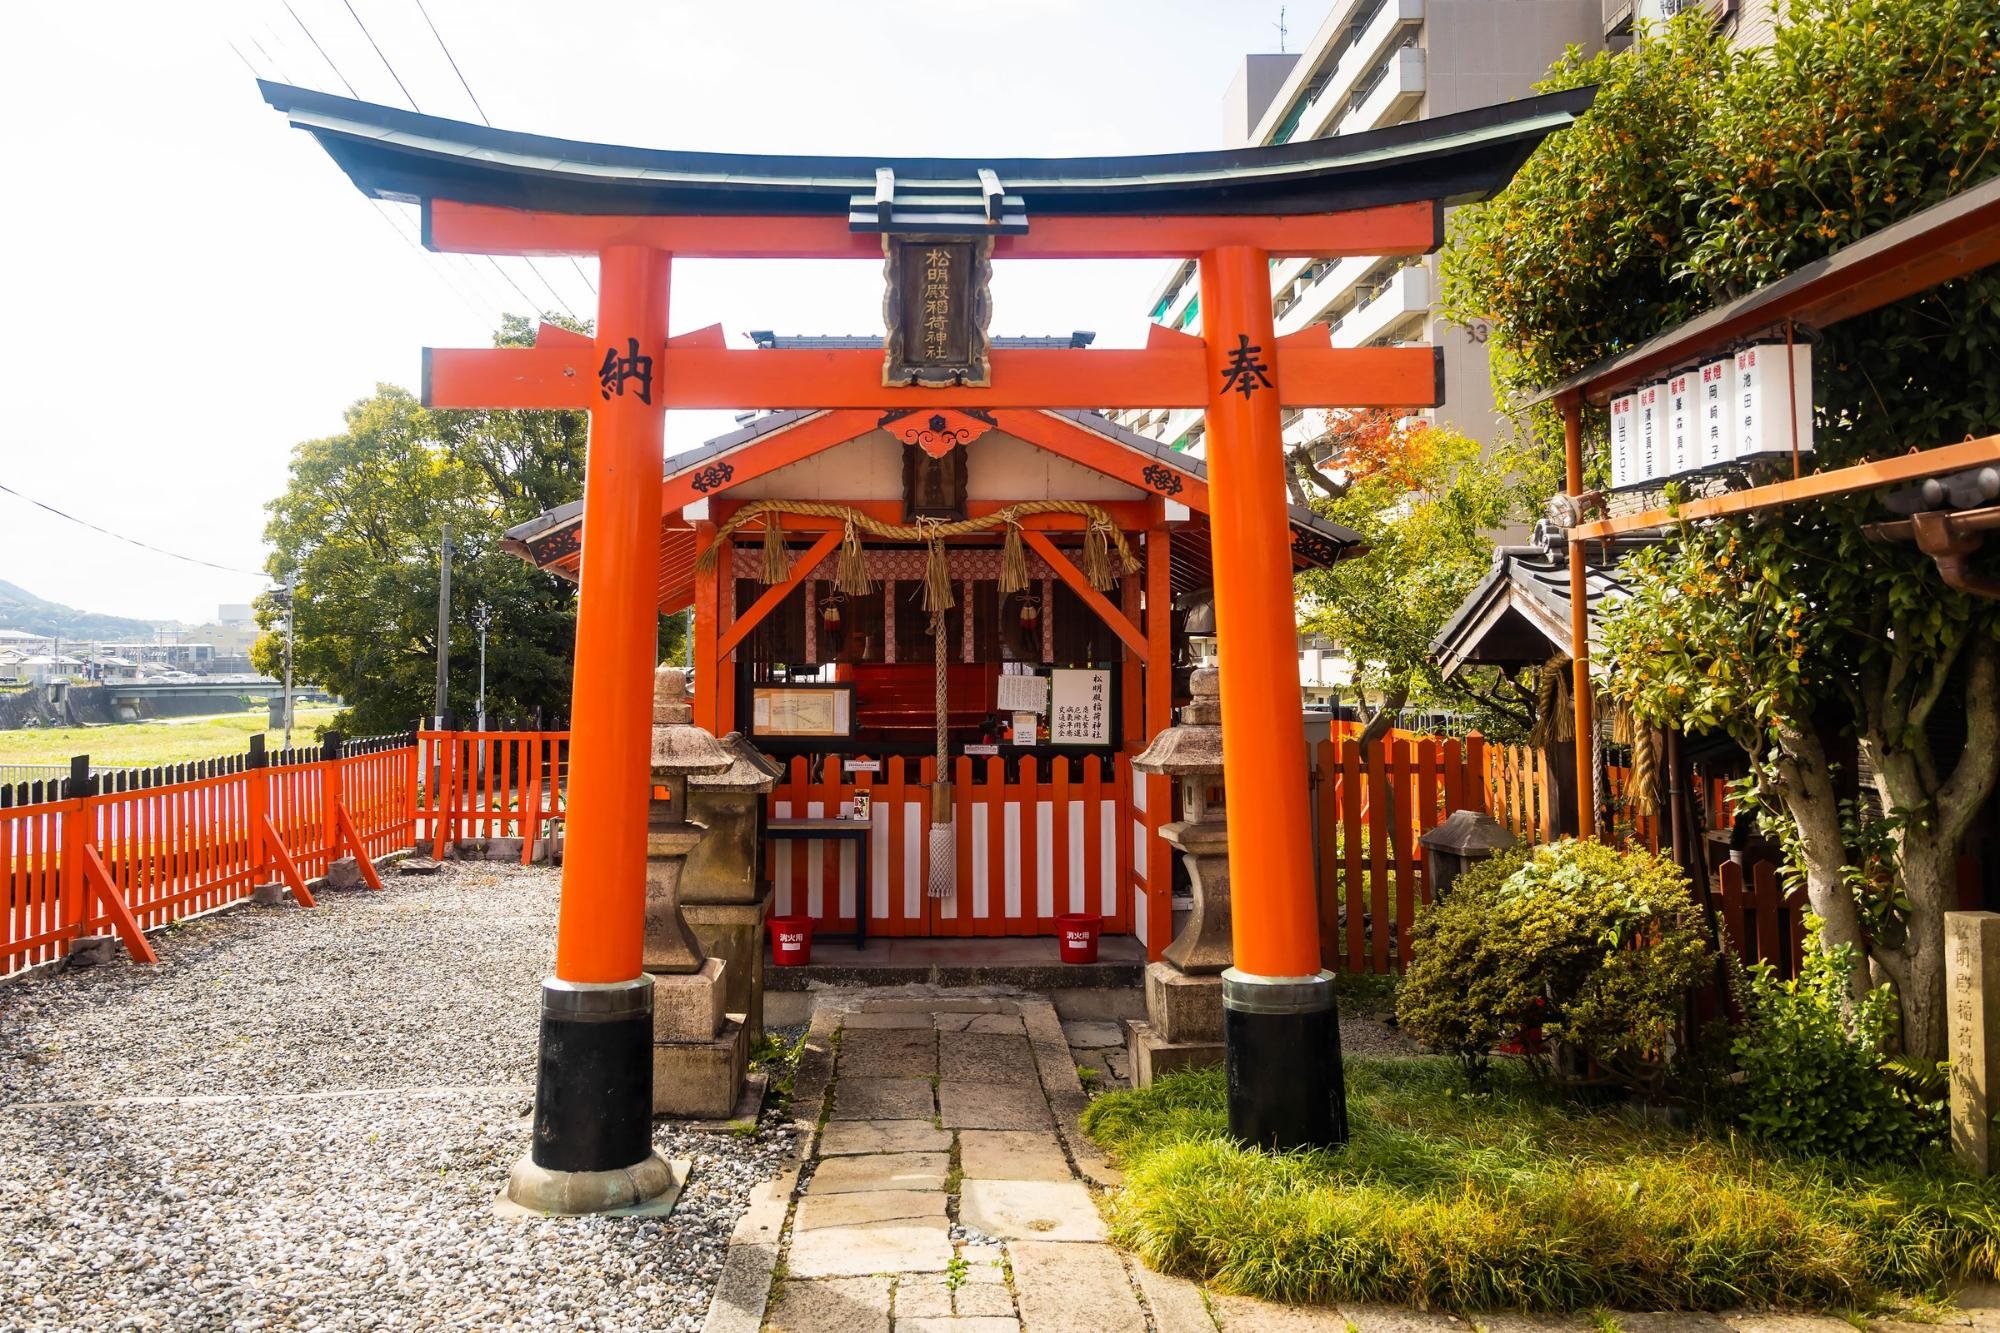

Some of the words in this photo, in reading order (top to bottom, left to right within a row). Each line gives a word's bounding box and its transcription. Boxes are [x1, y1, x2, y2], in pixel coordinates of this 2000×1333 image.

[599, 337, 653, 406] 納
[1219, 334, 1274, 401] 奉
[1057, 706, 1066, 737] 交通安全
[1092, 674, 1103, 739] 松明殿稲荷神社
[779, 933, 804, 942] 消火用
[1066, 931, 1090, 940] 消火用
